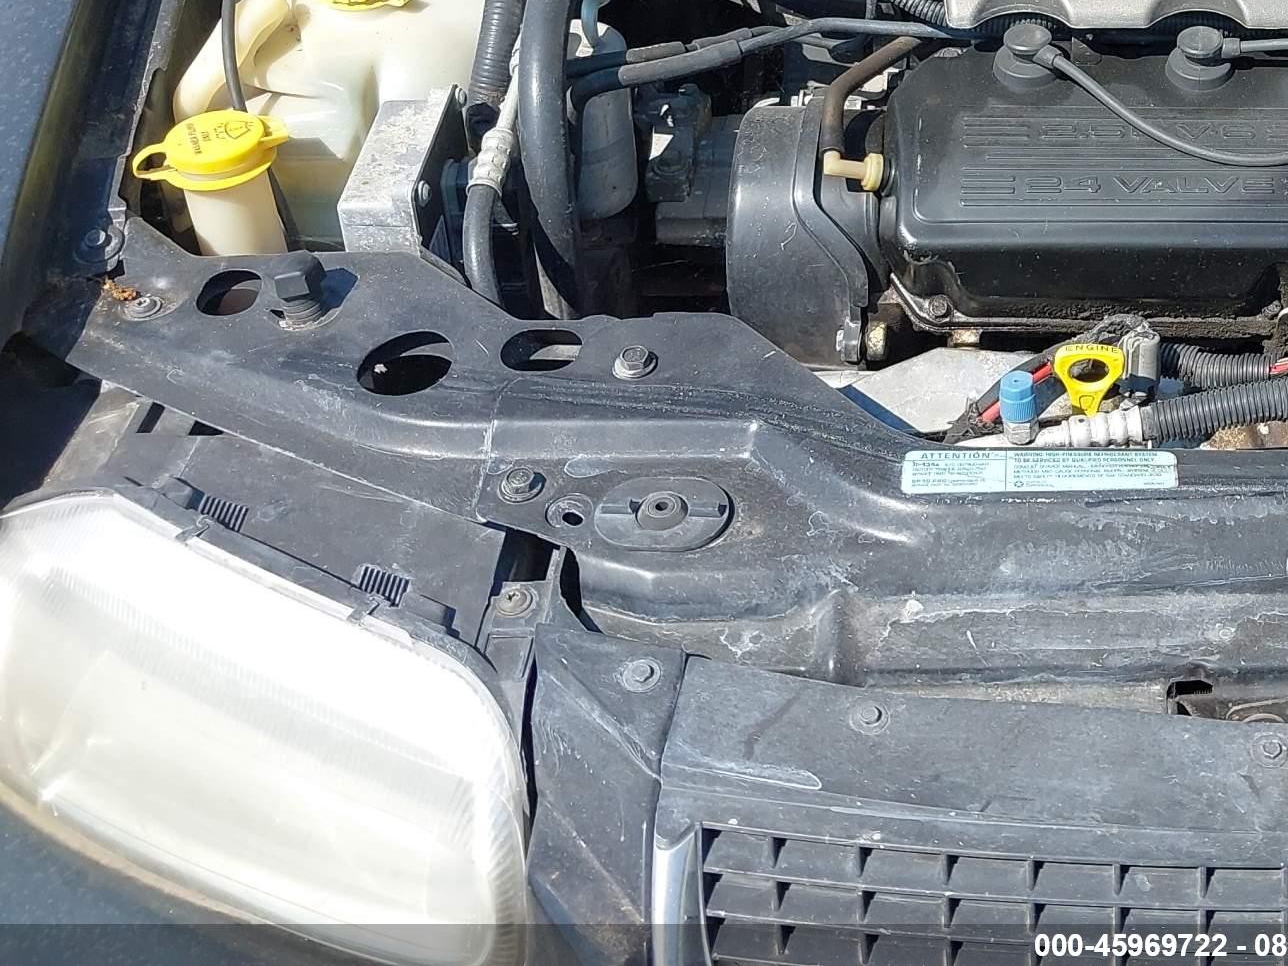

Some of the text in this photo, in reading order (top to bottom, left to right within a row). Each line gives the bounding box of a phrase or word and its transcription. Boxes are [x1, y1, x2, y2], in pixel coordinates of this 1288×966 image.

[1025, 176, 1275, 194] 24 VALVE
[1065, 344, 1119, 354] ENGINE
